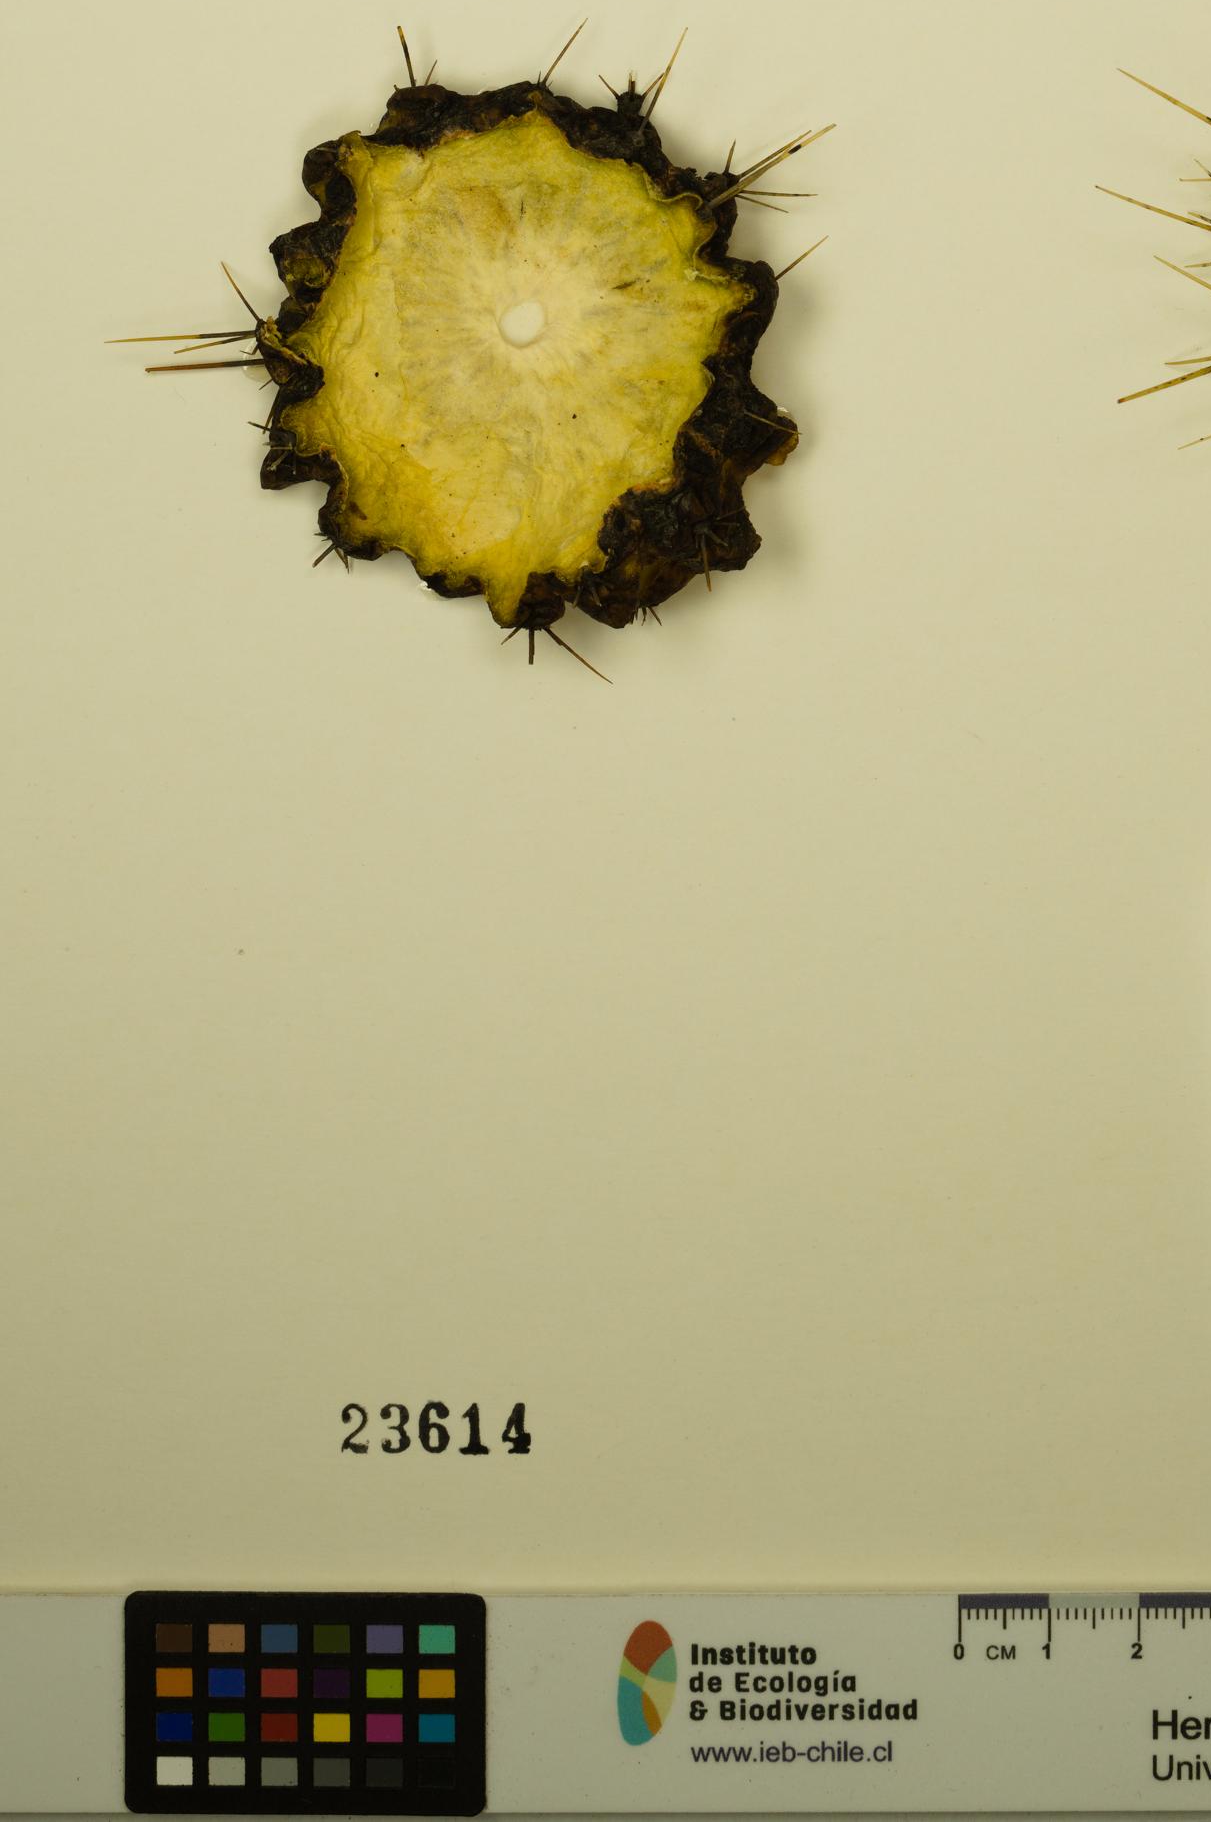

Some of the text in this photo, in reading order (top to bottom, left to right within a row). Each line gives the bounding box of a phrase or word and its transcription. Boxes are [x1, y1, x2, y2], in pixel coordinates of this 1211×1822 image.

[340, 1400, 532, 1456] 23614
[690, 1641, 817, 1666] Instituto
[953, 1642, 965, 1661] 0
[986, 1644, 1016, 1661] CM
[1041, 1641, 1052, 1660] 1
[1130, 1641, 1143, 1660] 2
[688, 1669, 857, 1698] de Ecología
[689, 1697, 918, 1722] & Biodiversidad
[690, 1740, 893, 1763] www.ieb-chile.cl
